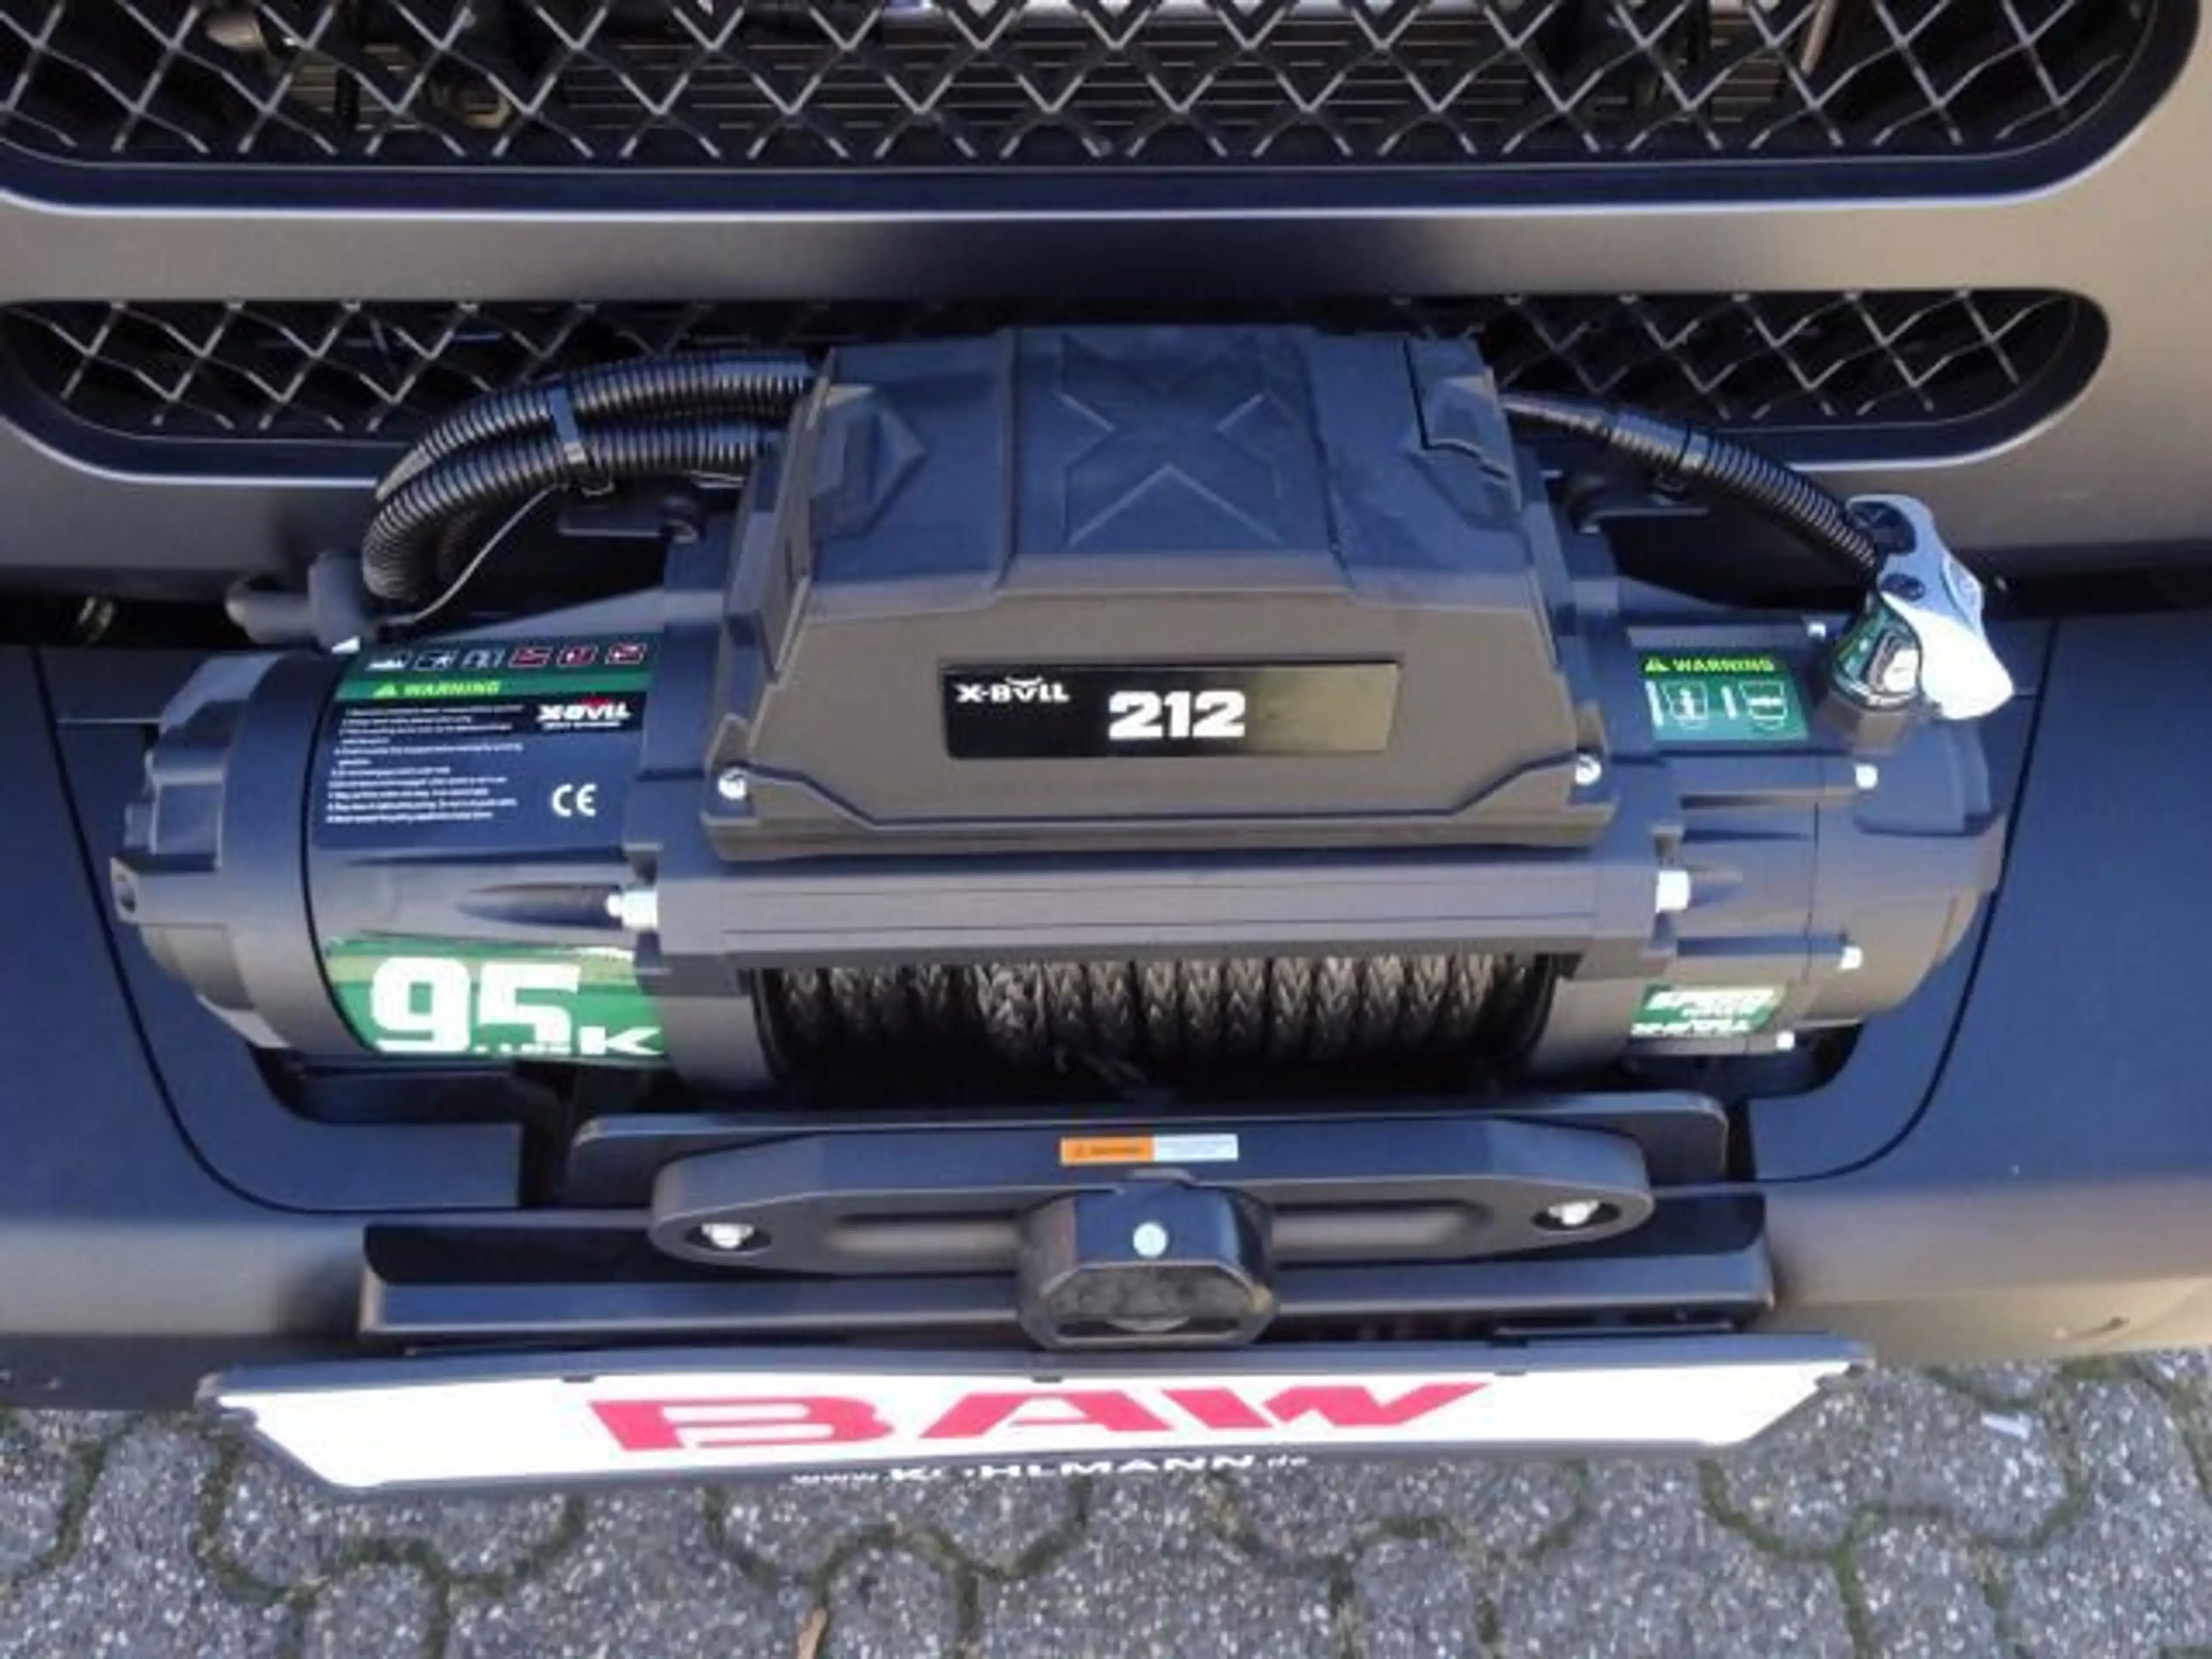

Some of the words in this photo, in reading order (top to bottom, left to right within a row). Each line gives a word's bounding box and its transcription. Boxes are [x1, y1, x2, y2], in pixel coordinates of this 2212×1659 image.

[1672, 658, 1774, 673] WARNING
[404, 680, 502, 697] WARNING
[1108, 691, 1245, 740] 212
[551, 783, 597, 817] CE
[588, 1381, 1493, 1452] BAW
